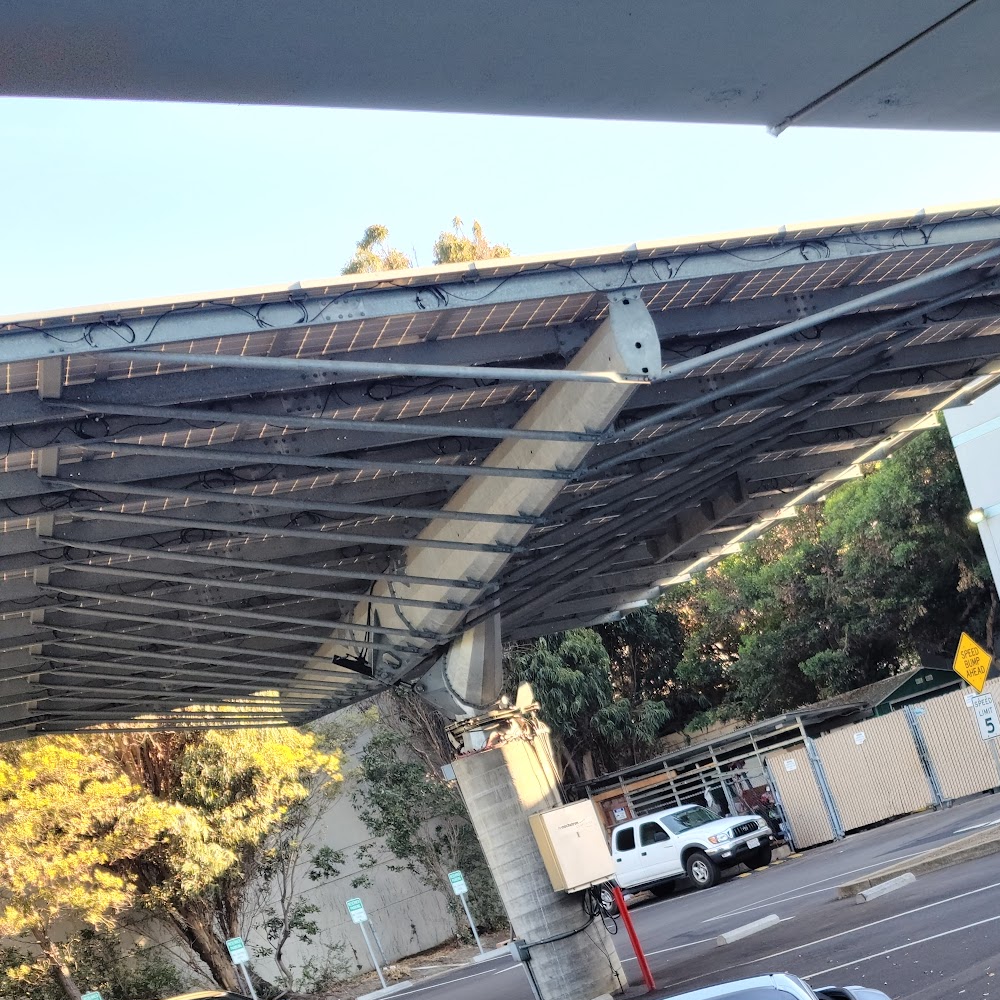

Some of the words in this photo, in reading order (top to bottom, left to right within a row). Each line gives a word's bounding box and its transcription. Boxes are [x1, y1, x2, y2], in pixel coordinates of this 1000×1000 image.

[960, 647, 980, 659] SPEED
[964, 657, 981, 669] BUMP
[966, 666, 985, 677] AHEAD
[973, 697, 993, 708] SPEED
[979, 707, 993, 717] LIMIT
[984, 717, 995, 734] 5
